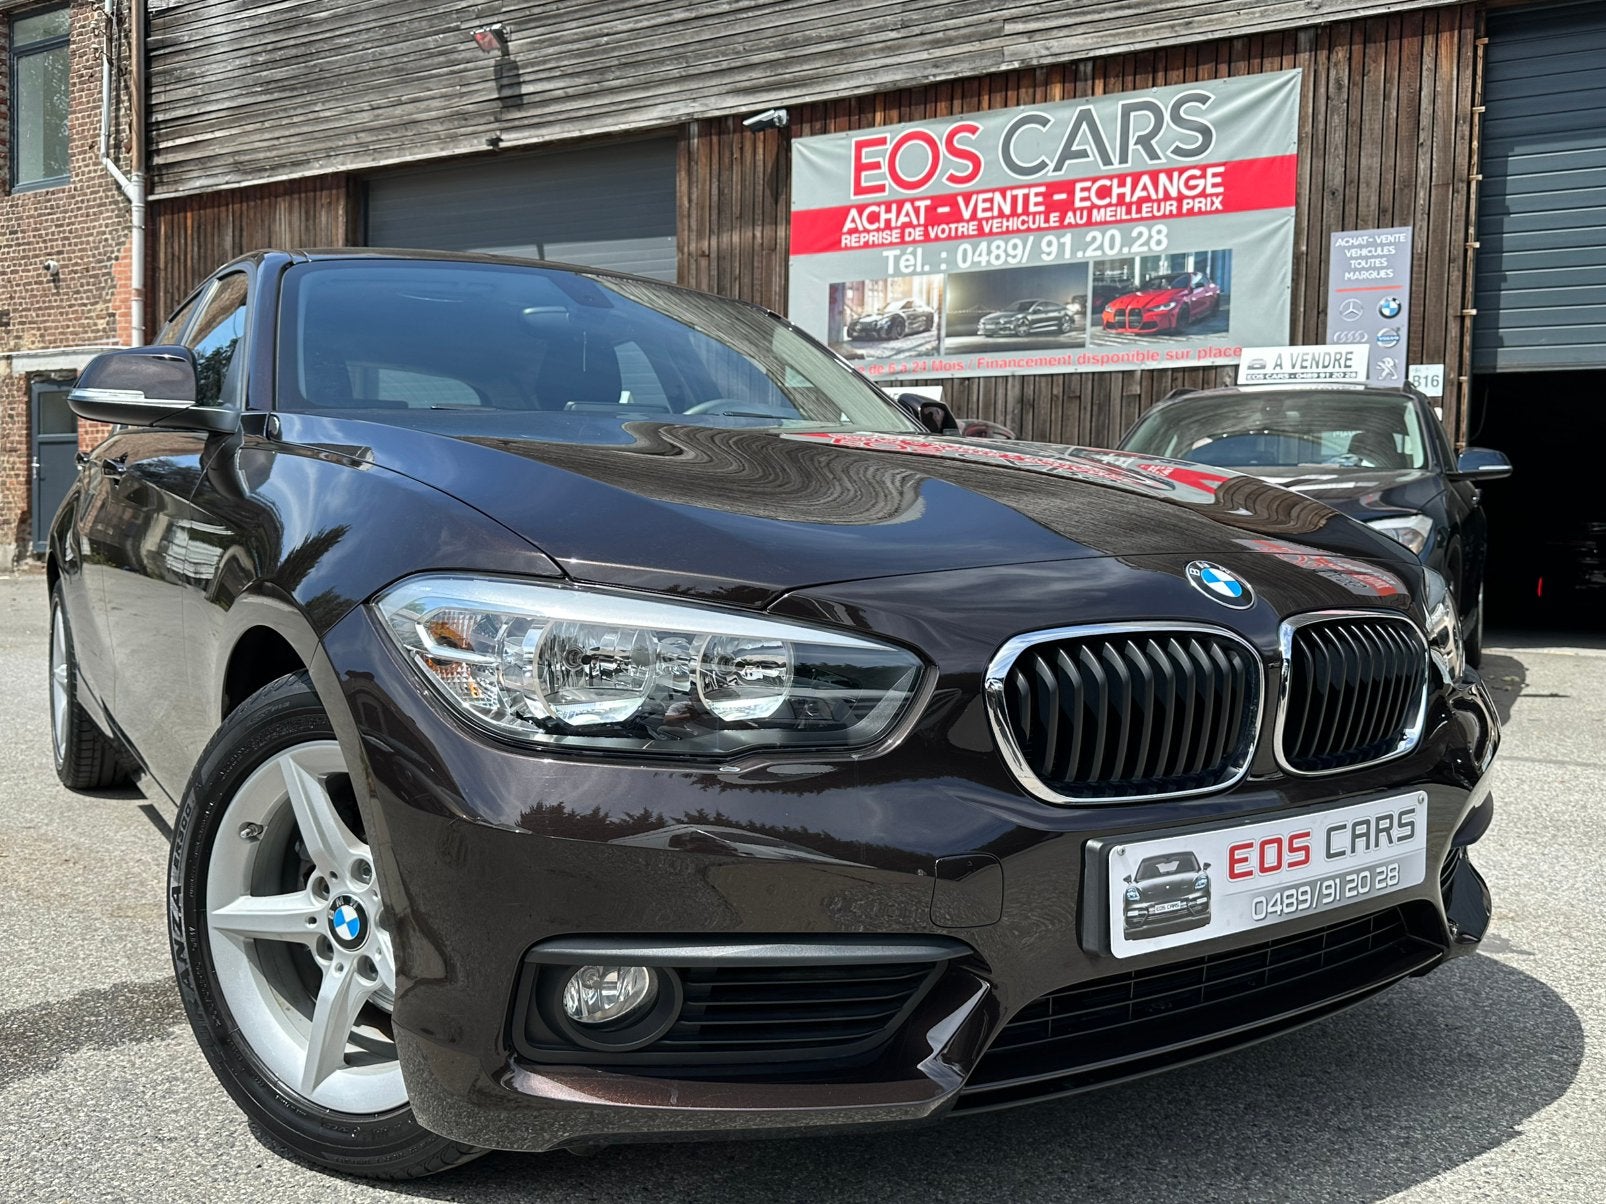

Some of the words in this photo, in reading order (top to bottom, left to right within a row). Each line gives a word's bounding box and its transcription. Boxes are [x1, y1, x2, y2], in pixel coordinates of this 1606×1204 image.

[851, 121, 984, 199] EOS
[998, 90, 1216, 179] CARS
[842, 200, 931, 232] ACHAT
[957, 186, 1046, 219] VENTE
[1074, 166, 1225, 208] ECHANGE
[841, 230, 900, 247] REPRISE
[905, 227, 924, 241] DE
[928, 222, 978, 238] VOTRE
[982, 212, 1060, 233] VEHICULE
[1064, 209, 1087, 224] AU
[1092, 201, 1177, 222] MEILLEUR
[1182, 196, 1223, 213] PRIX
[1374, 233, 1406, 244] VENTE
[882, 247, 930, 274] Tél.
[956, 236, 1034, 268] 0489/
[1040, 224, 1168, 261] 91.20.28
[1345, 246, 1396, 257] VEHICULES
[1350, 258, 1387, 268] TOUTES
[1344, 269, 1394, 280] MARQUES
[868, 364, 884, 375] de
[931, 358, 964, 372] Mois
[977, 354, 1073, 369] Financement
[1077, 348, 1160, 366] disponible
[1166, 348, 1191, 361] sur
[1197, 345, 1242, 363] place
[1273, 353, 1283, 370] A
[1290, 351, 1354, 370] VENDRE
[1227, 829, 1311, 881] EOS
[1325, 806, 1416, 861] CARS
[1251, 877, 1341, 921] 0489/91
[1345, 871, 1370, 898] 20
[1375, 863, 1399, 889] 28
